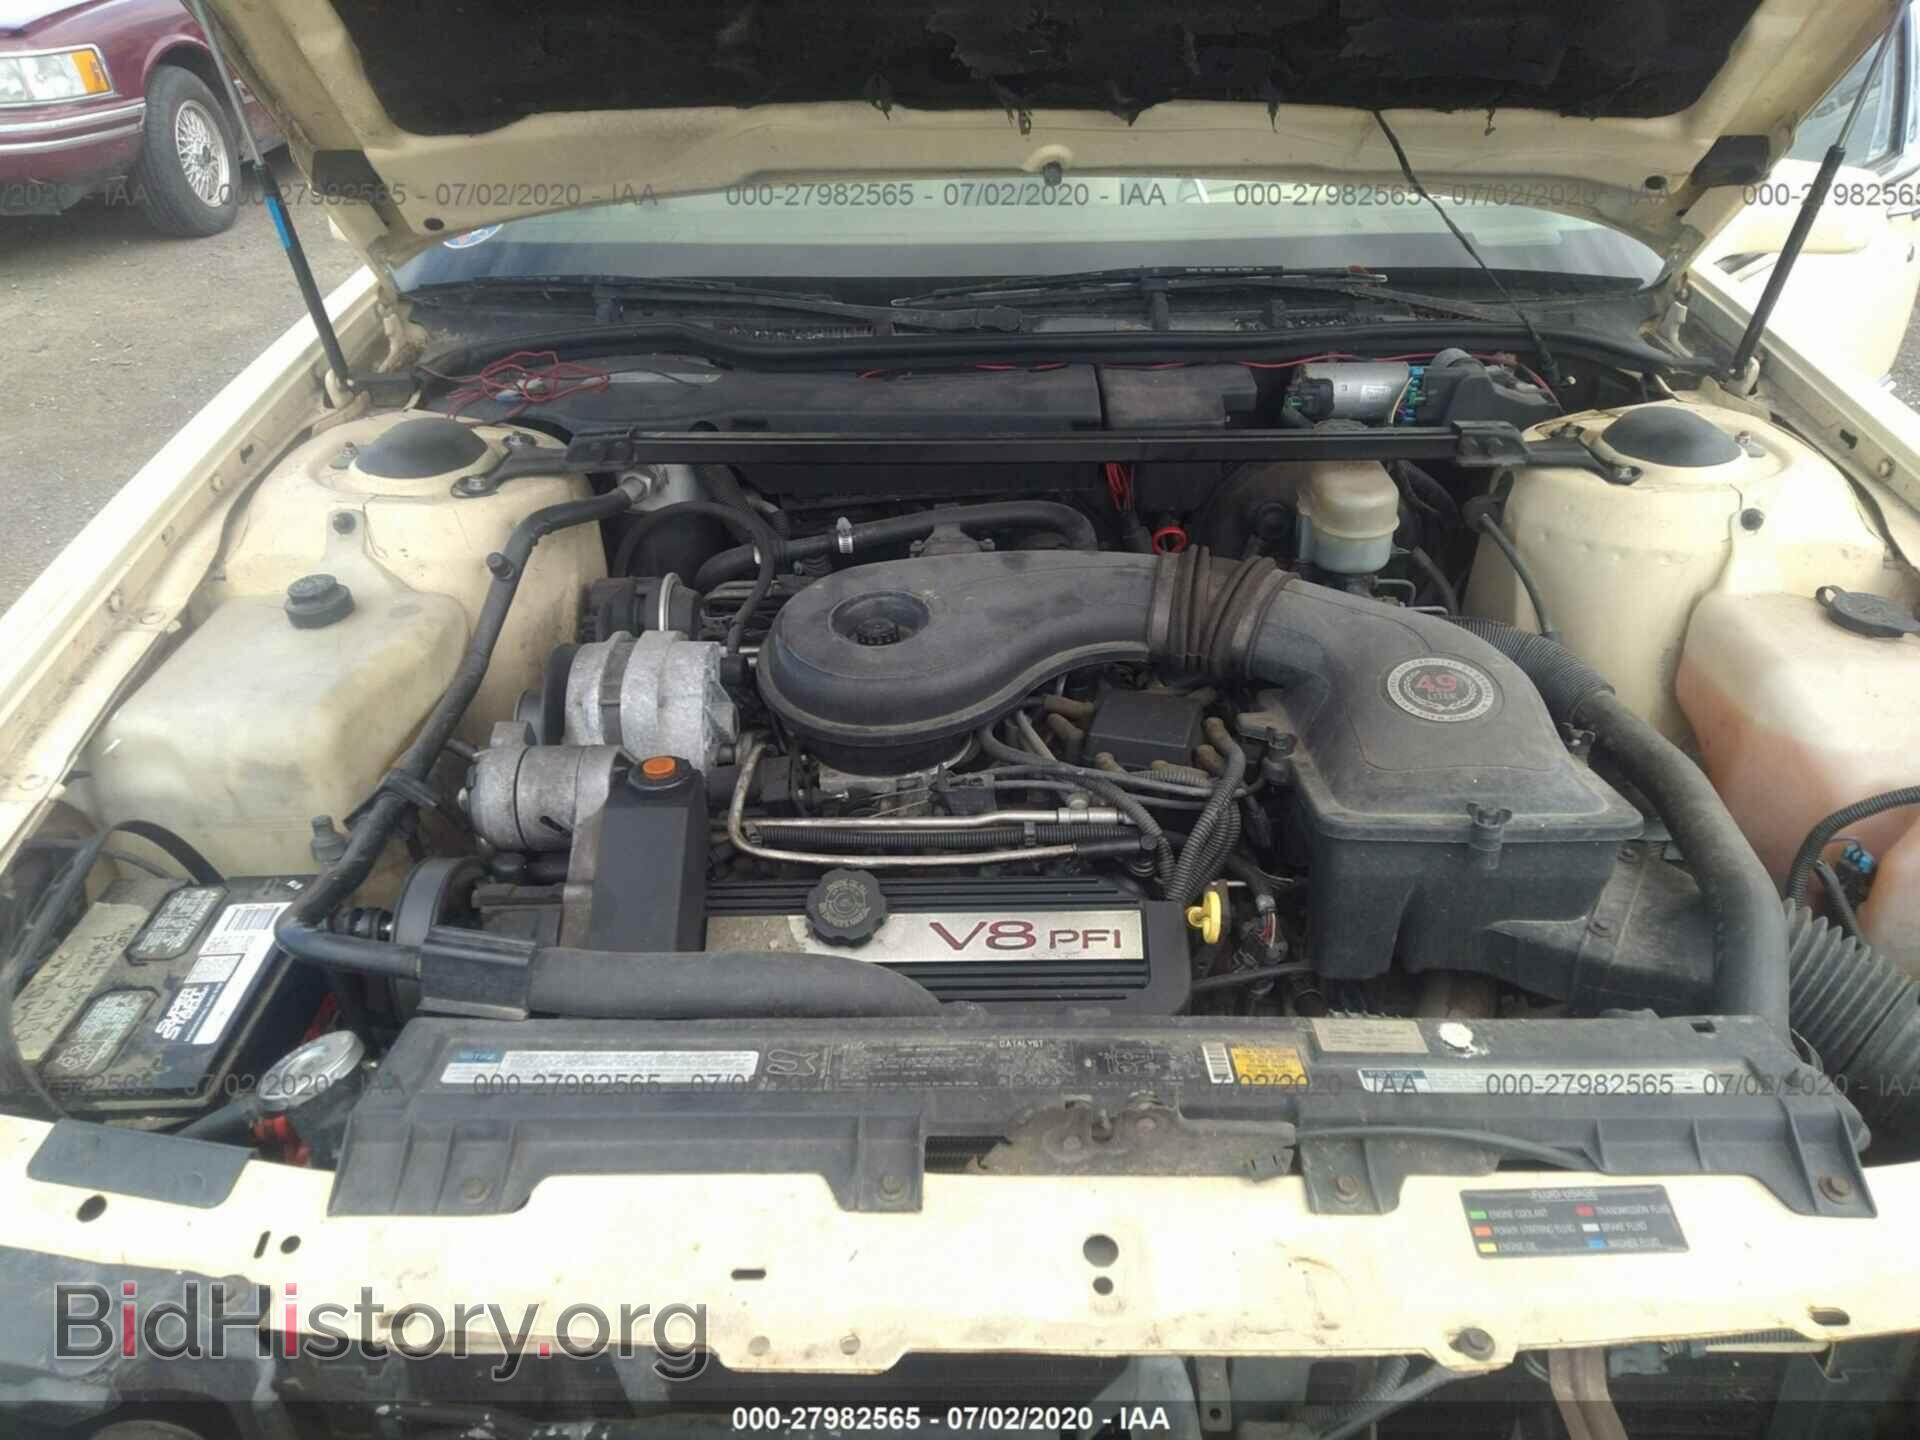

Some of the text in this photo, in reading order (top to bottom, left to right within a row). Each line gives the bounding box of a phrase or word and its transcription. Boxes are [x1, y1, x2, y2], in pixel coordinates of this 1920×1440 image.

[929, 920, 1122, 951] V8 PFI
[999, 1039, 1044, 1049] CATALYST
